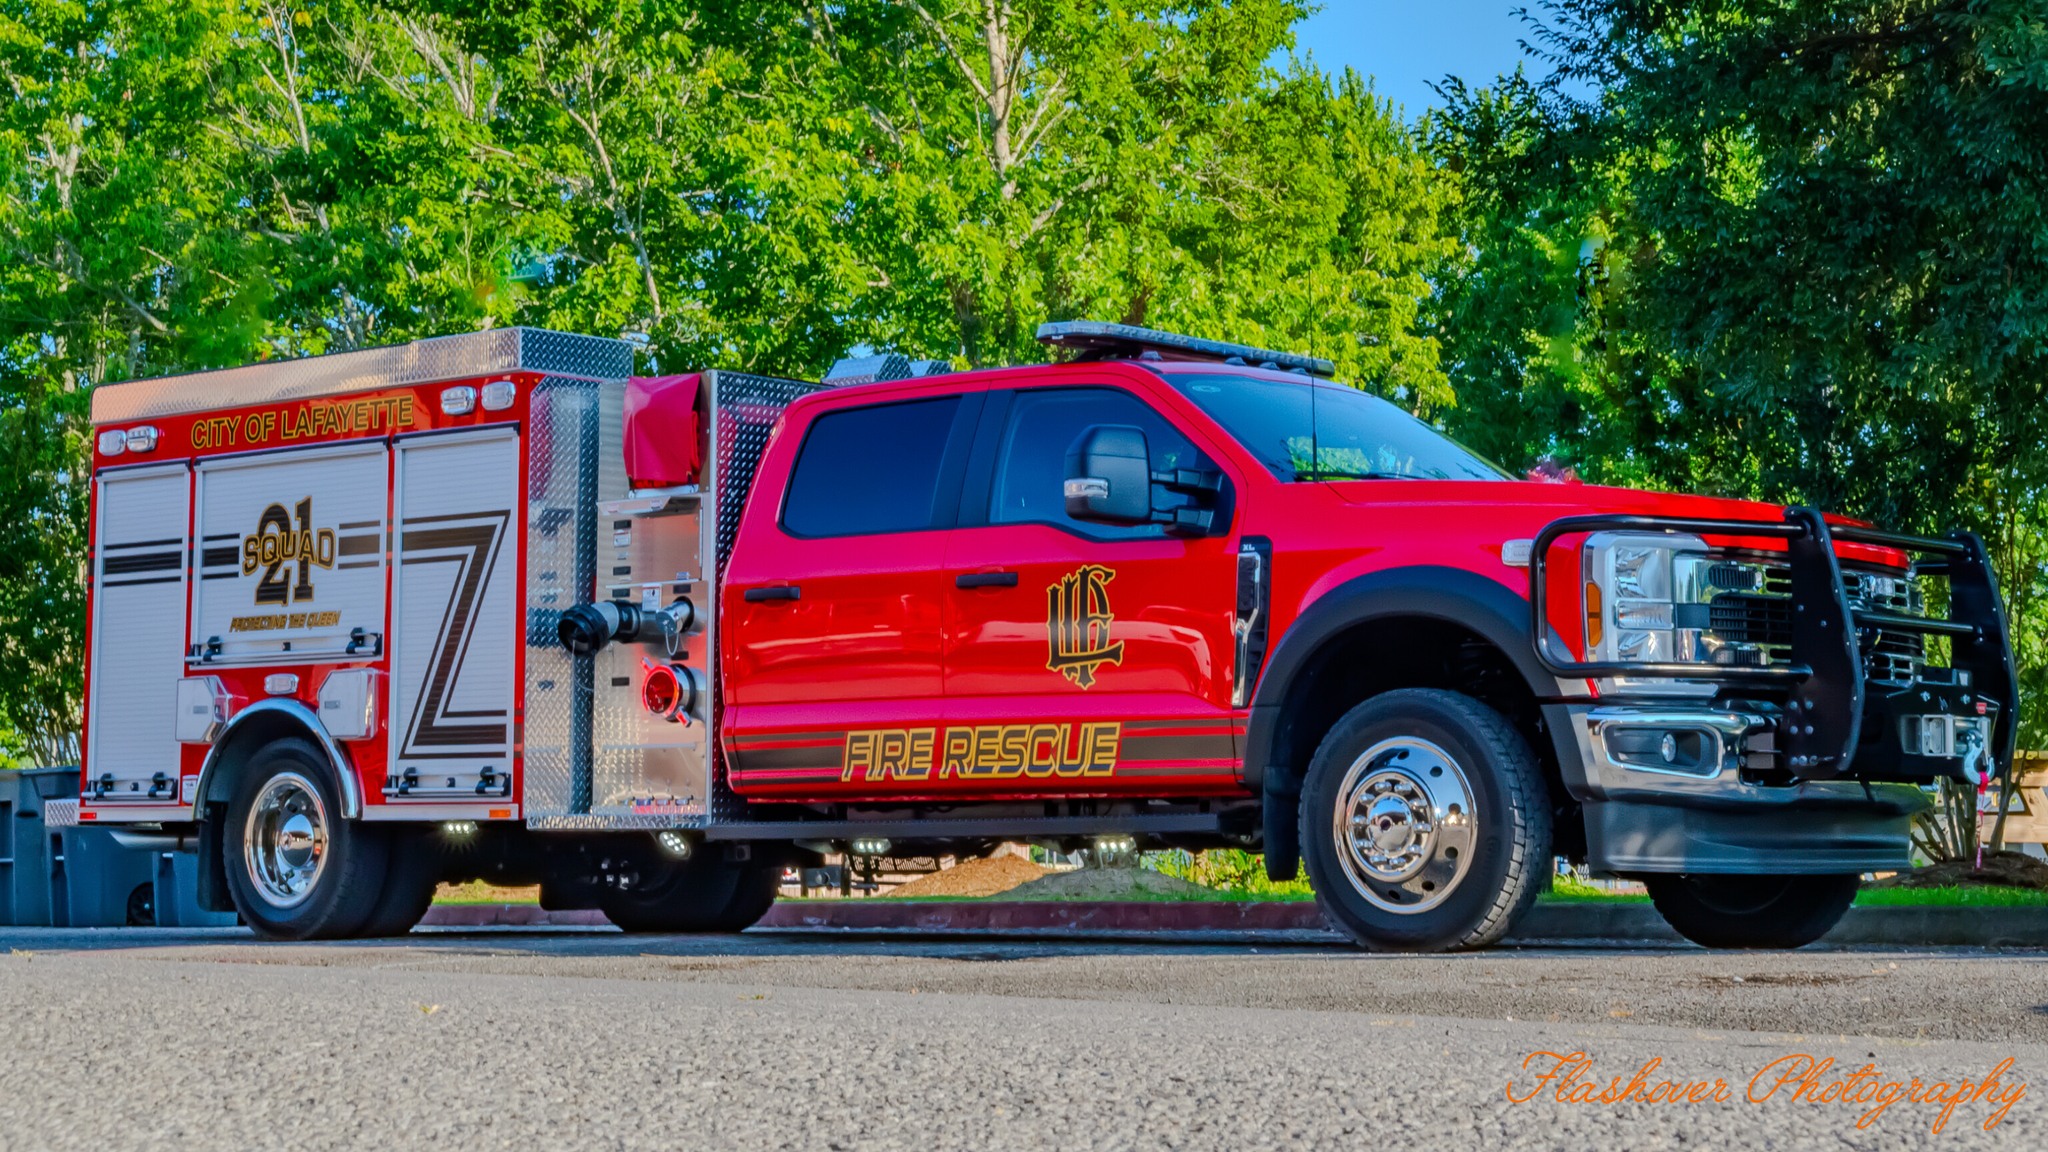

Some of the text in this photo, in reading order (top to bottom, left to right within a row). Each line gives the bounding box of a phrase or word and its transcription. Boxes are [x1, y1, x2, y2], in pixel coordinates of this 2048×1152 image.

[191, 395, 414, 450] CITY OF LAFAYETTE
[242, 528, 336, 576] SQUAD
[228, 611, 341, 633] PROTECTING THE QUEEN
[841, 722, 1121, 782] FIRE RESCUE
